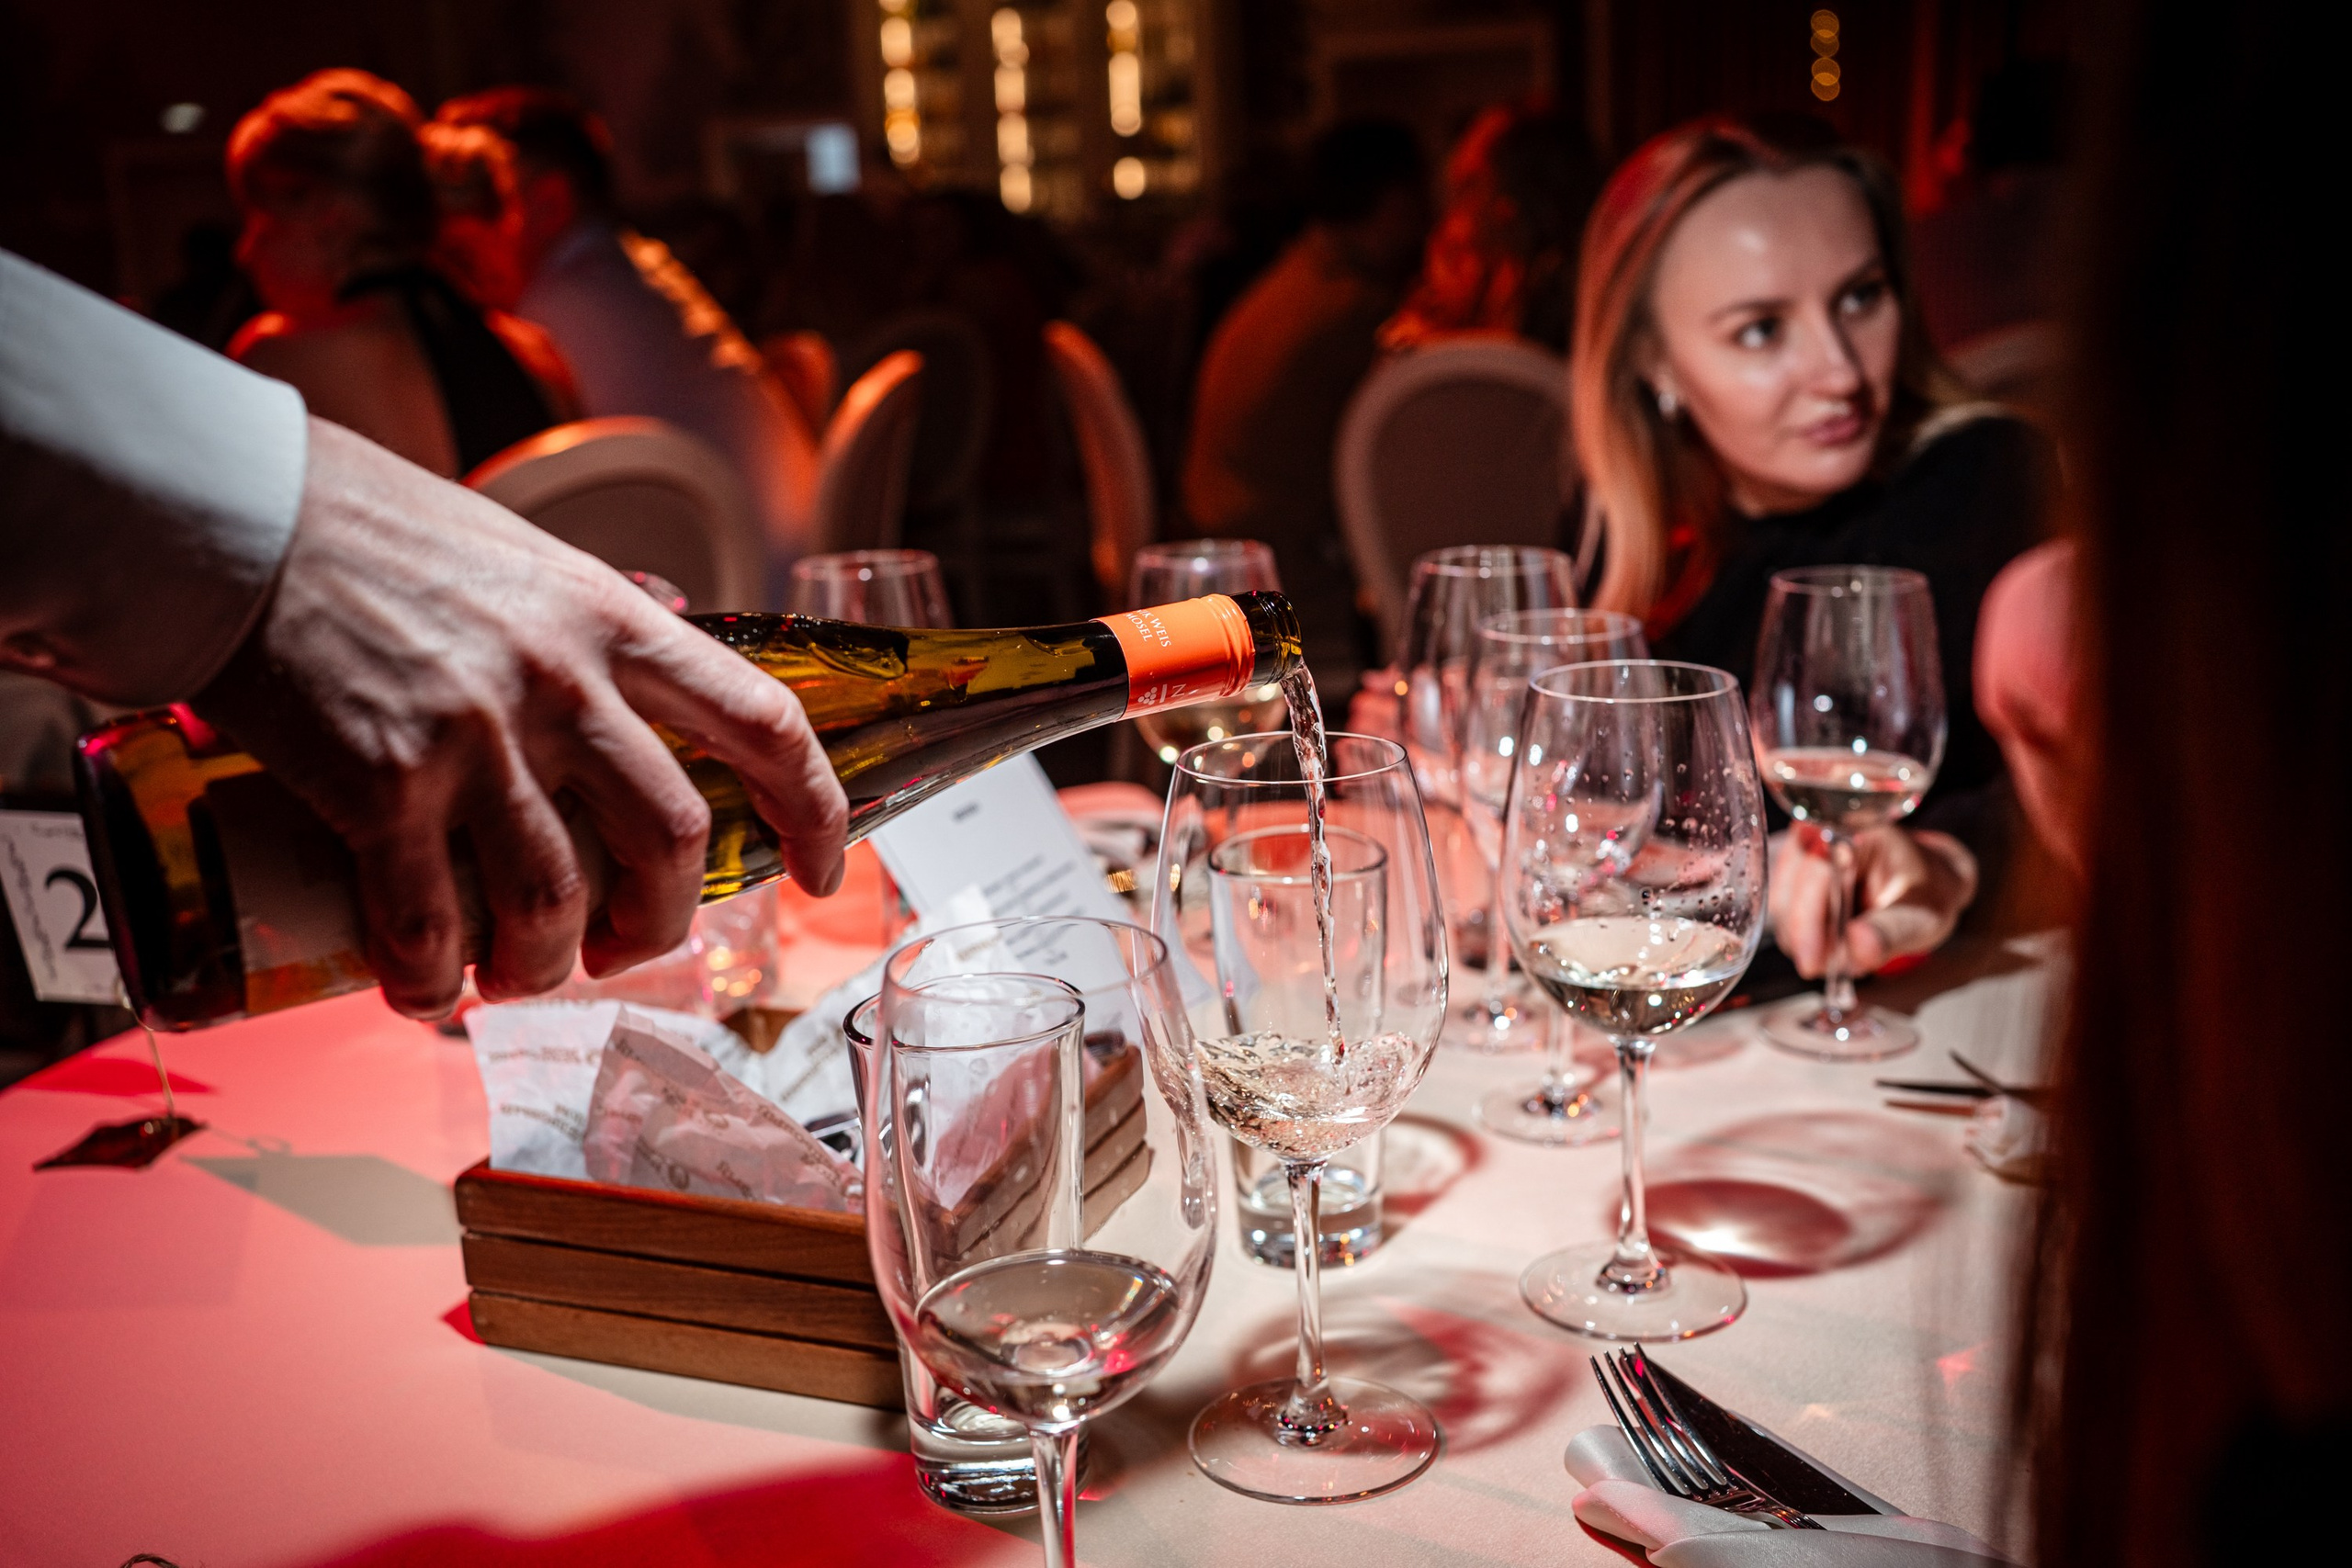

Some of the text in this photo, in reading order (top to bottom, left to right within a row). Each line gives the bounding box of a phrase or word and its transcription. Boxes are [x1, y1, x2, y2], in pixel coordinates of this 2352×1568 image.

[1124, 614, 1153, 641] MOSEL
[1150, 618, 1171, 647] WEIS
[46, 869, 114, 951] 2
